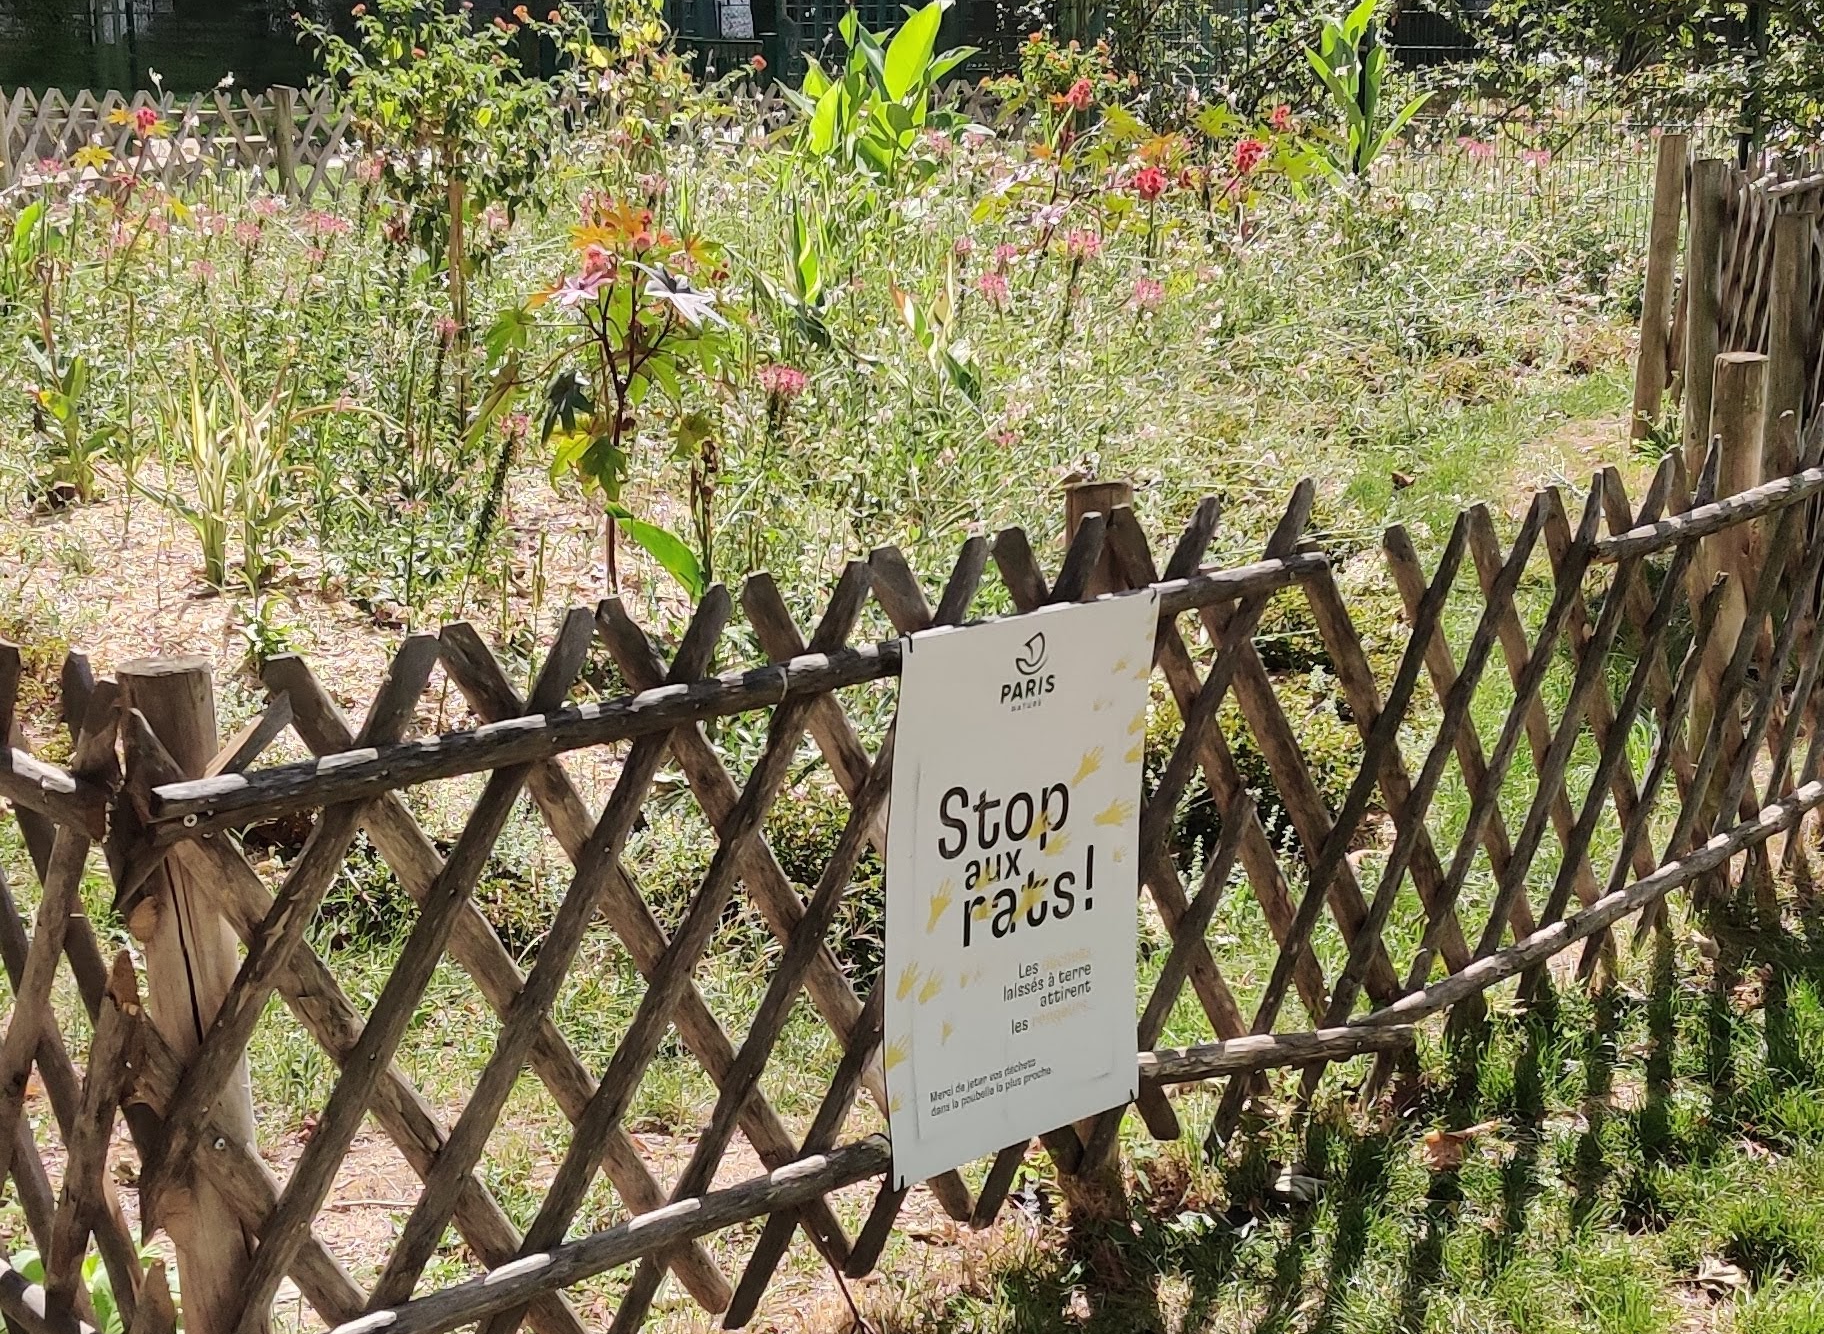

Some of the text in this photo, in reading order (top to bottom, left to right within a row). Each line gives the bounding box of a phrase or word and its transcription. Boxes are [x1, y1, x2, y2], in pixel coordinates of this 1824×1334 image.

[1000, 674, 1055, 704] PARIS
[938, 782, 1069, 860] Stop
[965, 848, 1022, 891] aux
[963, 844, 1094, 948] rats!
[1003, 963, 1092, 1002] laissés à terre
[1018, 962, 1039, 979] Les
[1040, 980, 1092, 1008] attirent
[1011, 1018, 1029, 1035] les
